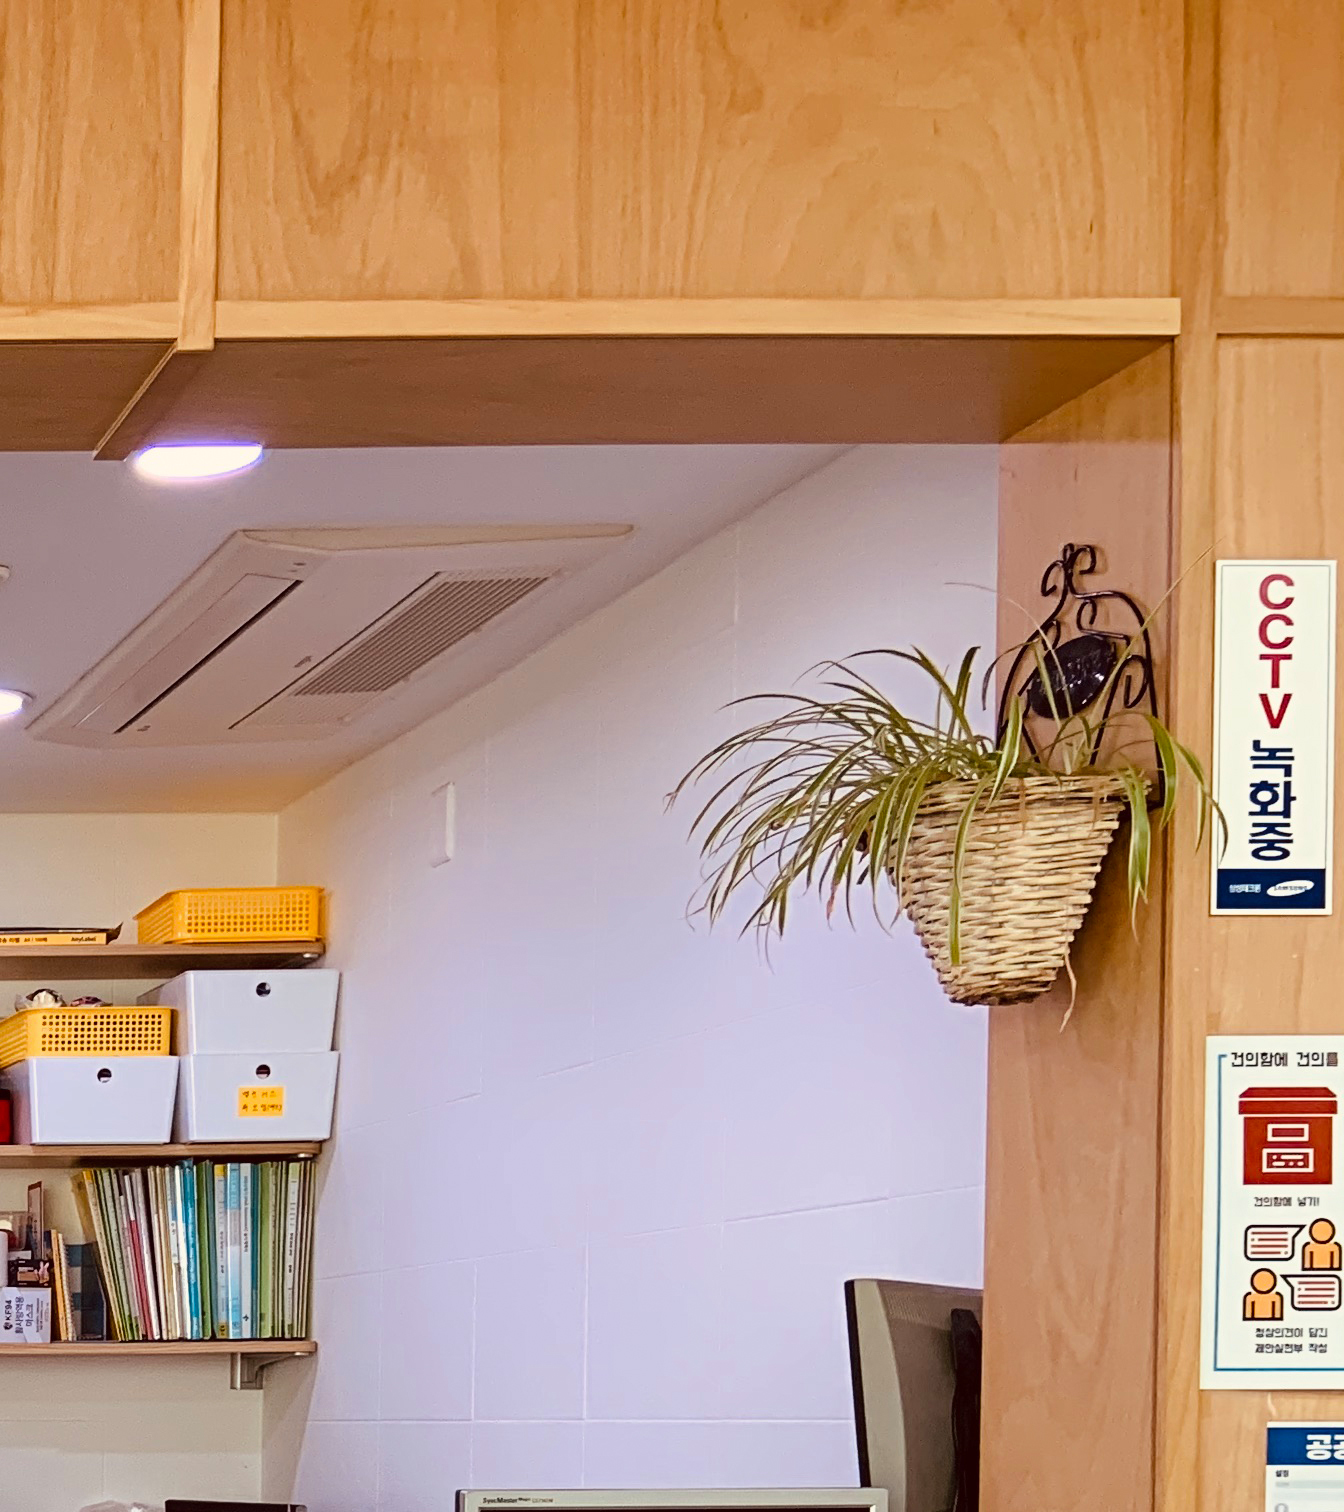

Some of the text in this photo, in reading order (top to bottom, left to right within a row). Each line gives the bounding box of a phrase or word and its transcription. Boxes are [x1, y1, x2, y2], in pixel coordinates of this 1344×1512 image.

[1258, 573, 1295, 729] CCTV
[1248, 739, 1297, 862] 녹화중
[1231, 1052, 1288, 1067] 건의함에
[25, 1303, 34, 1327] 마스크
